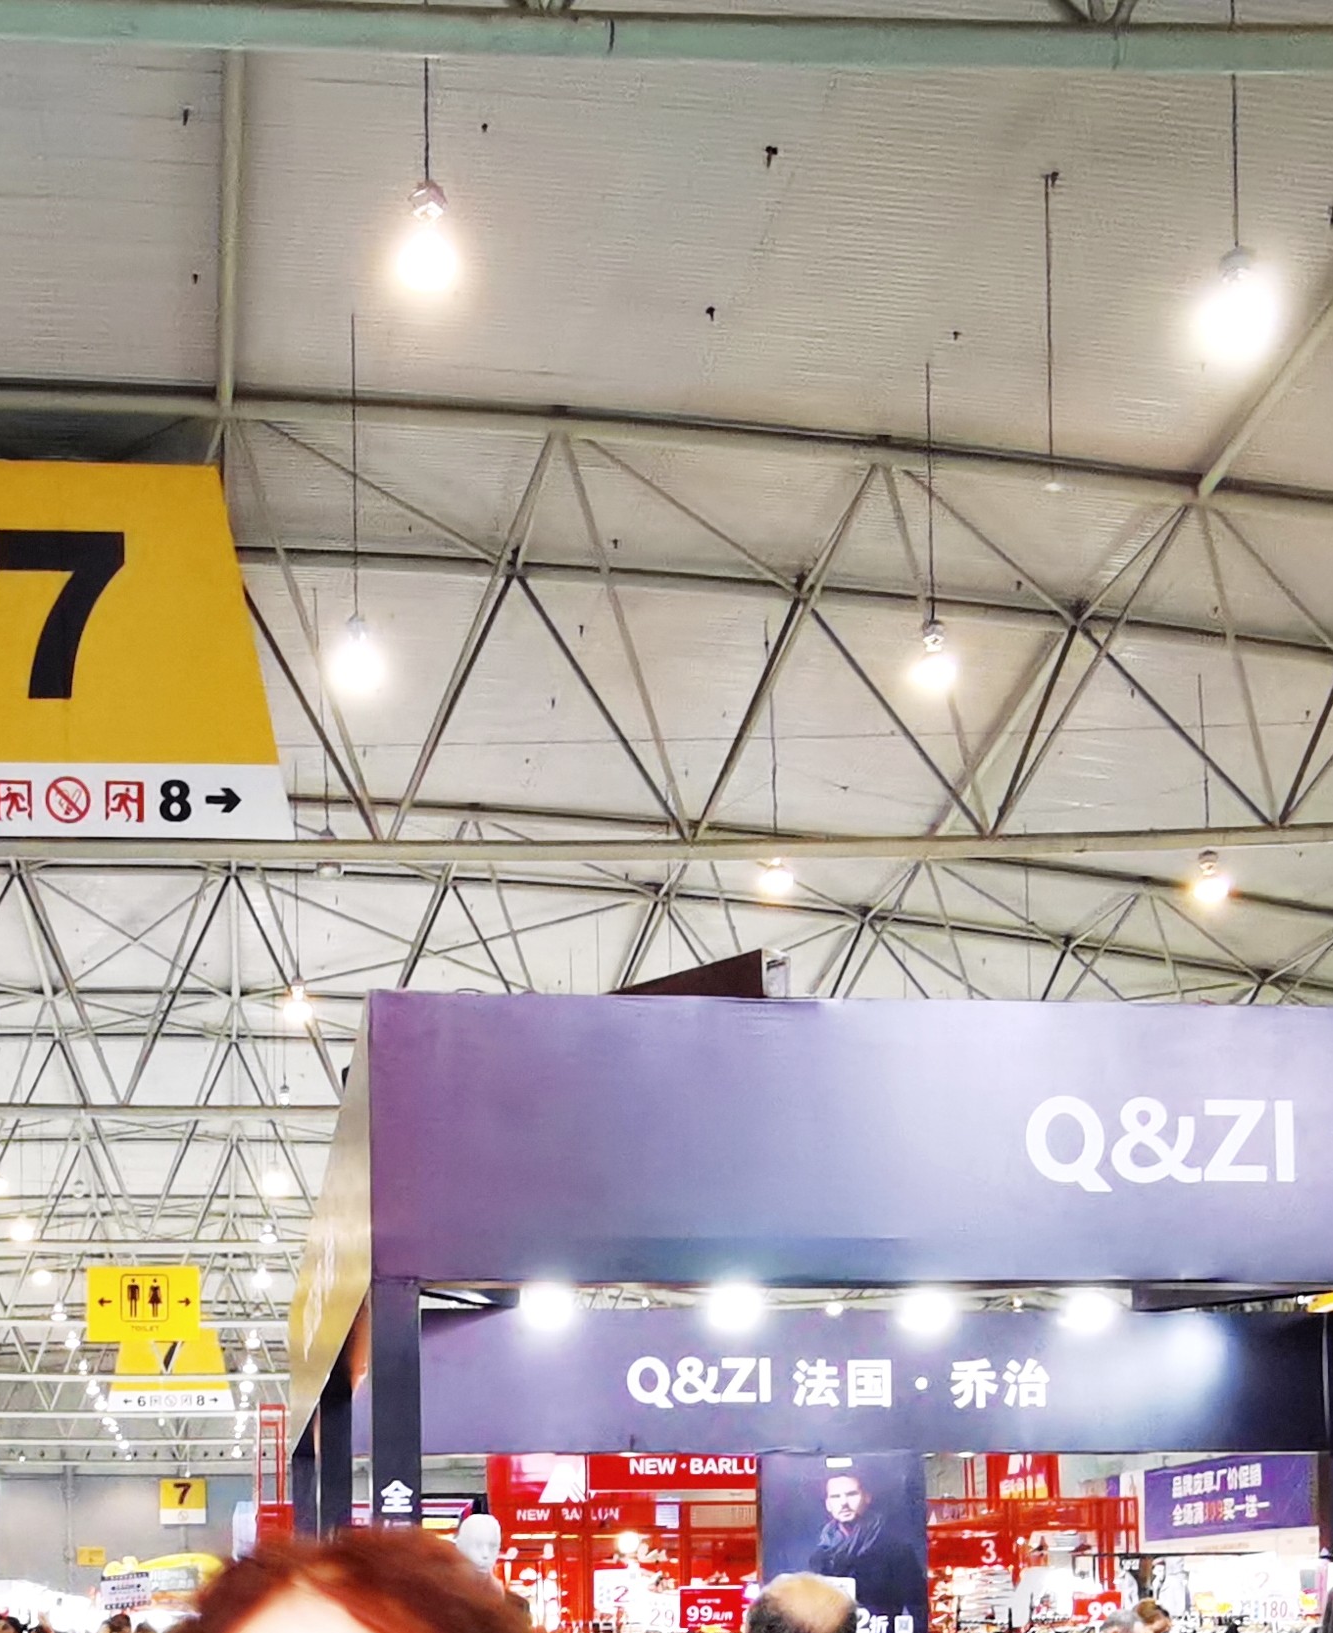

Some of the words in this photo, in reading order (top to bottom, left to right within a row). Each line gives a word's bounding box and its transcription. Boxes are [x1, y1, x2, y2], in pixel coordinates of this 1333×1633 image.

[159, 780, 192, 822] 8
[1024, 1095, 1296, 1193] Q&ZI
[625, 1355, 772, 1409] Q&ZI
[137, 1395, 147, 1407] 6
[196, 1394, 205, 1407] 8
[173, 1482, 192, 1506] 7
[517, 1508, 551, 1521] NEW
[650, 1608, 676, 1628] 29
